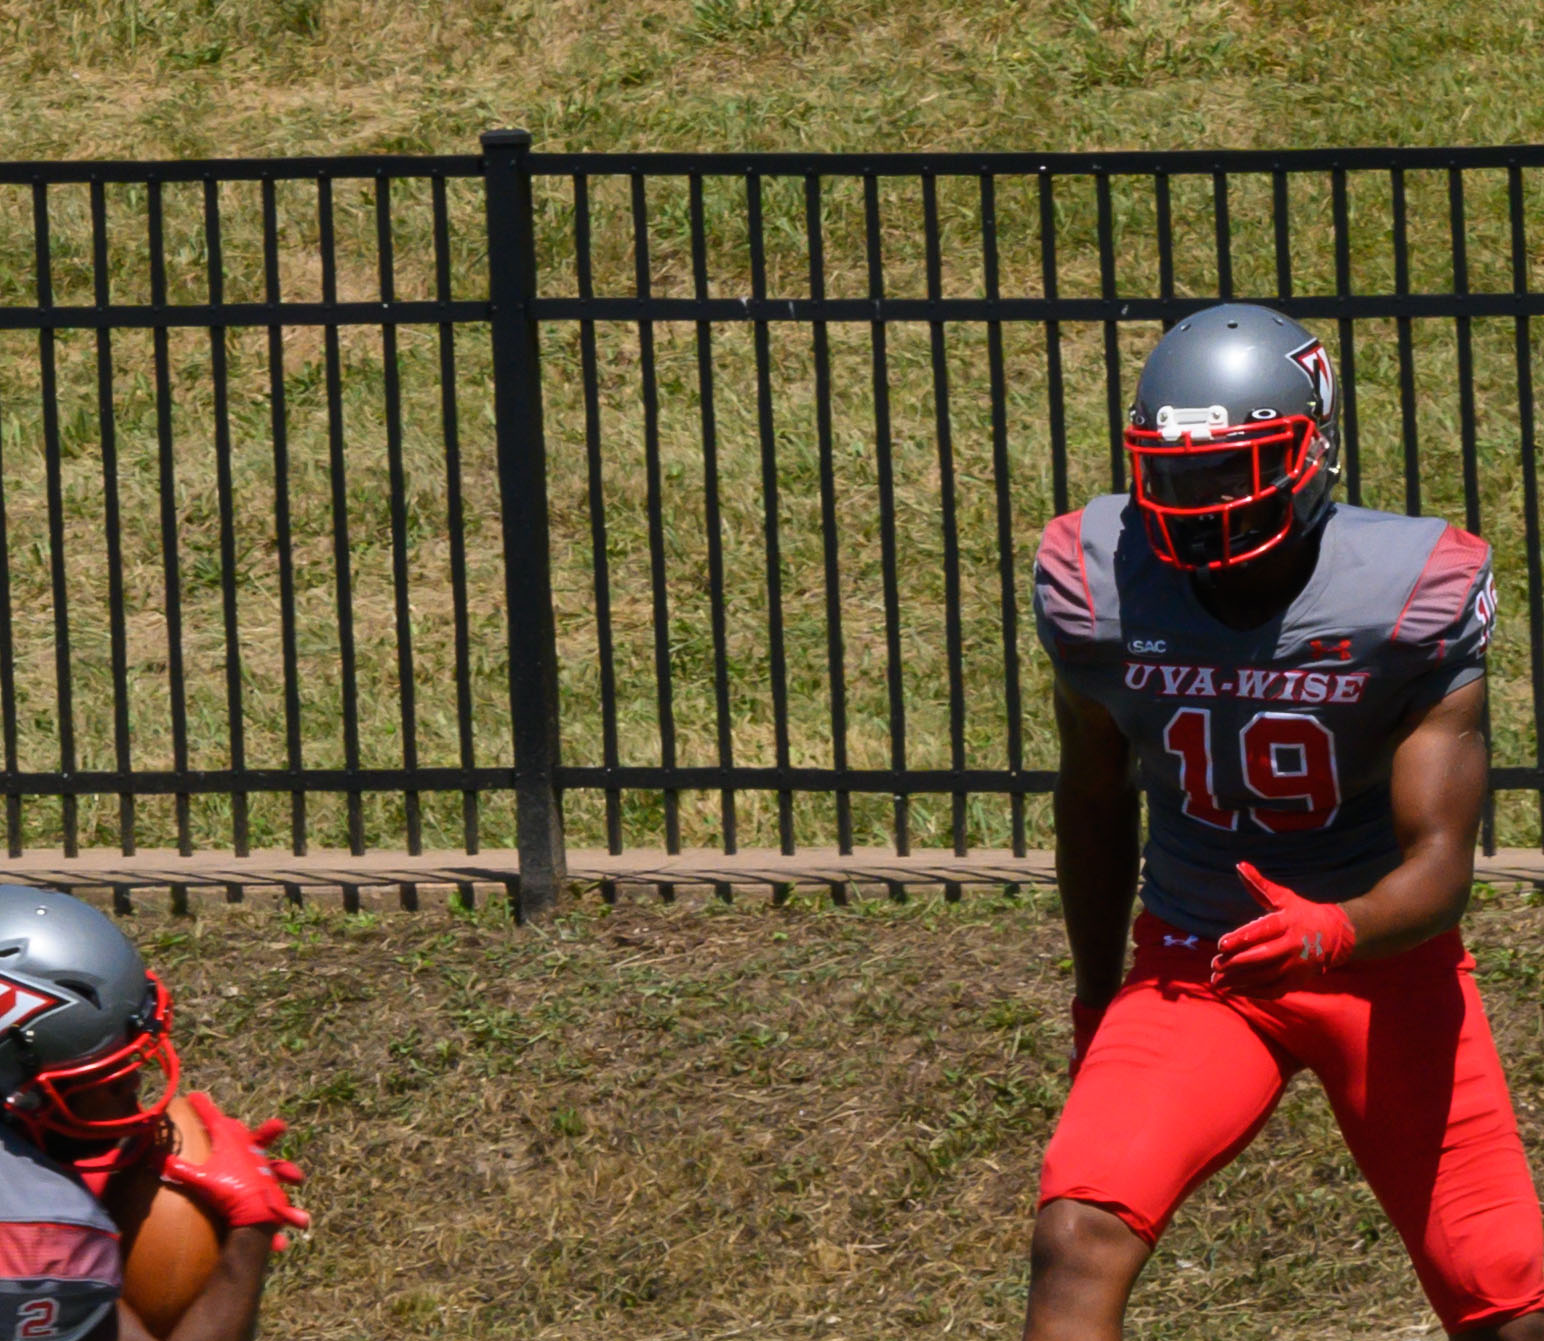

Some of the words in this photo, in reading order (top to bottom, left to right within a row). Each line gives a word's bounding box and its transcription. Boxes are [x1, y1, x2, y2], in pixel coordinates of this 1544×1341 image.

[1132, 639, 1167, 654] SAC
[1121, 661, 1371, 703] UVA-WISE
[1163, 706, 1342, 835] 19
[15, 1297, 60, 1339] 2
